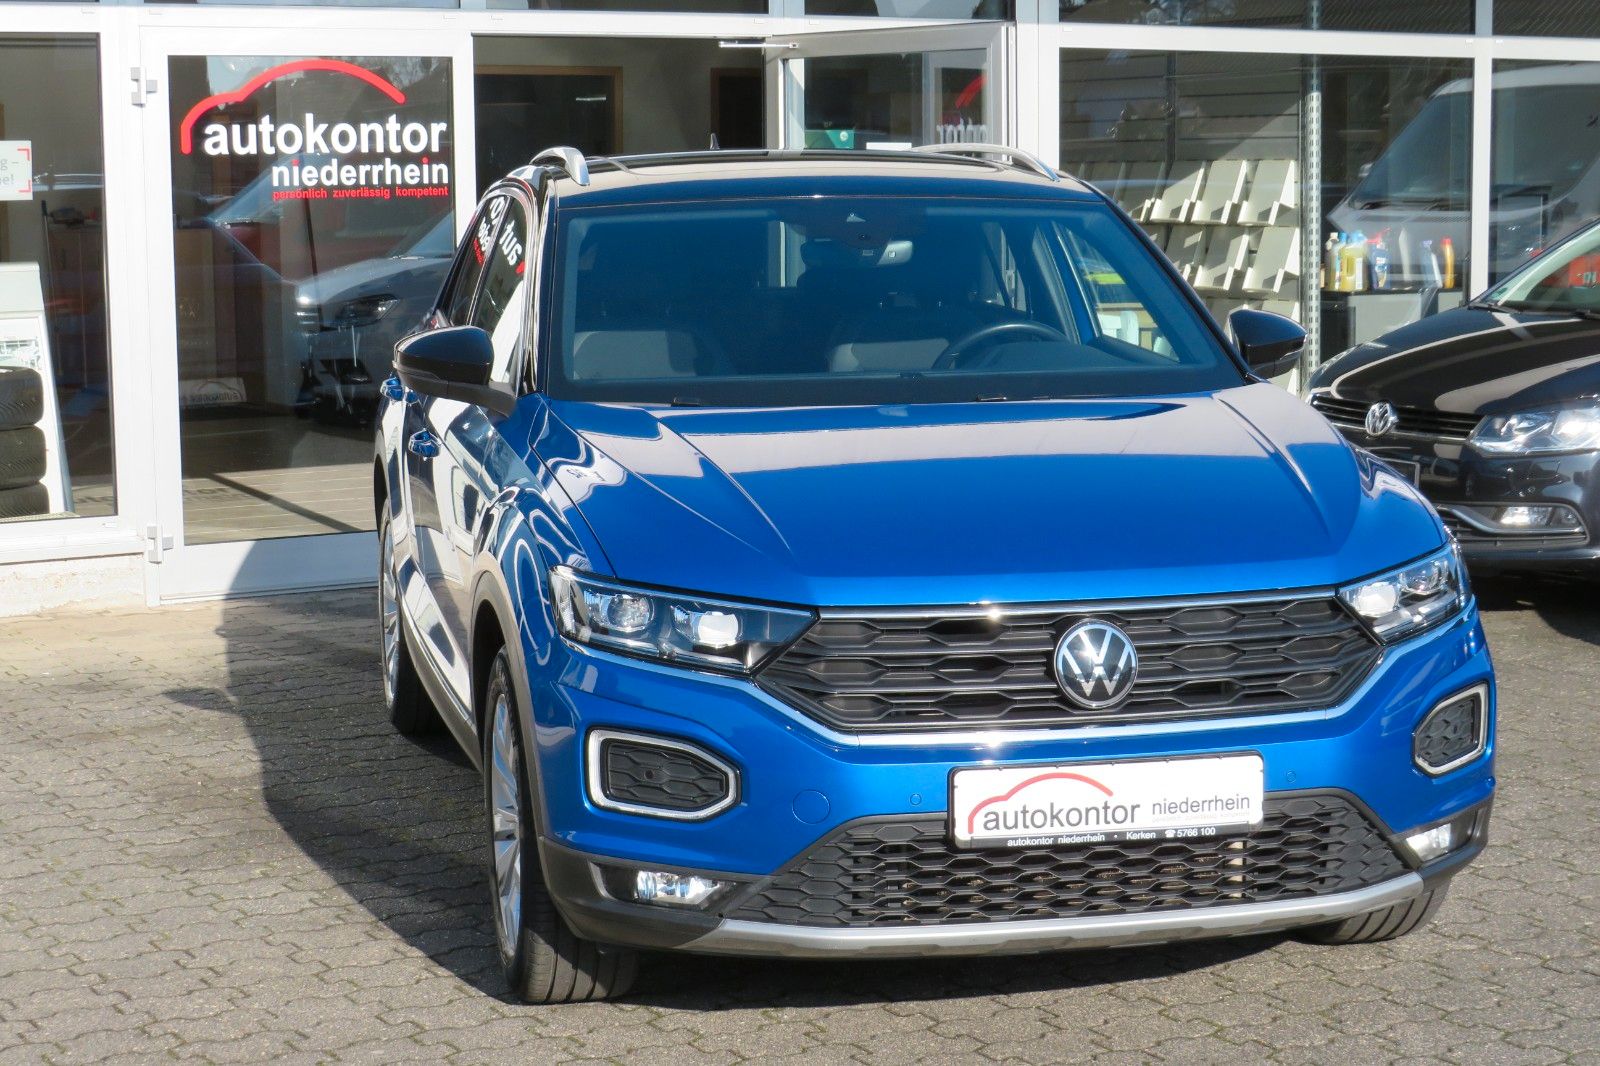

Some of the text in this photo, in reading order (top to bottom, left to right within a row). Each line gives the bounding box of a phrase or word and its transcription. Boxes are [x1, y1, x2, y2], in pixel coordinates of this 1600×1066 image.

[203, 112, 447, 156] autokontor
[271, 157, 449, 187] niederrhein
[272, 186, 449, 200] persönlich zuverlässig kompetent
[983, 801, 1140, 830] autokontor
[1152, 793, 1250, 815] niederrhein
[1007, 837, 1054, 847] autokontor
[1057, 834, 1105, 845] niederrhein
[1126, 831, 1156, 841] Kerken
[1200, 826, 1216, 837] 100
